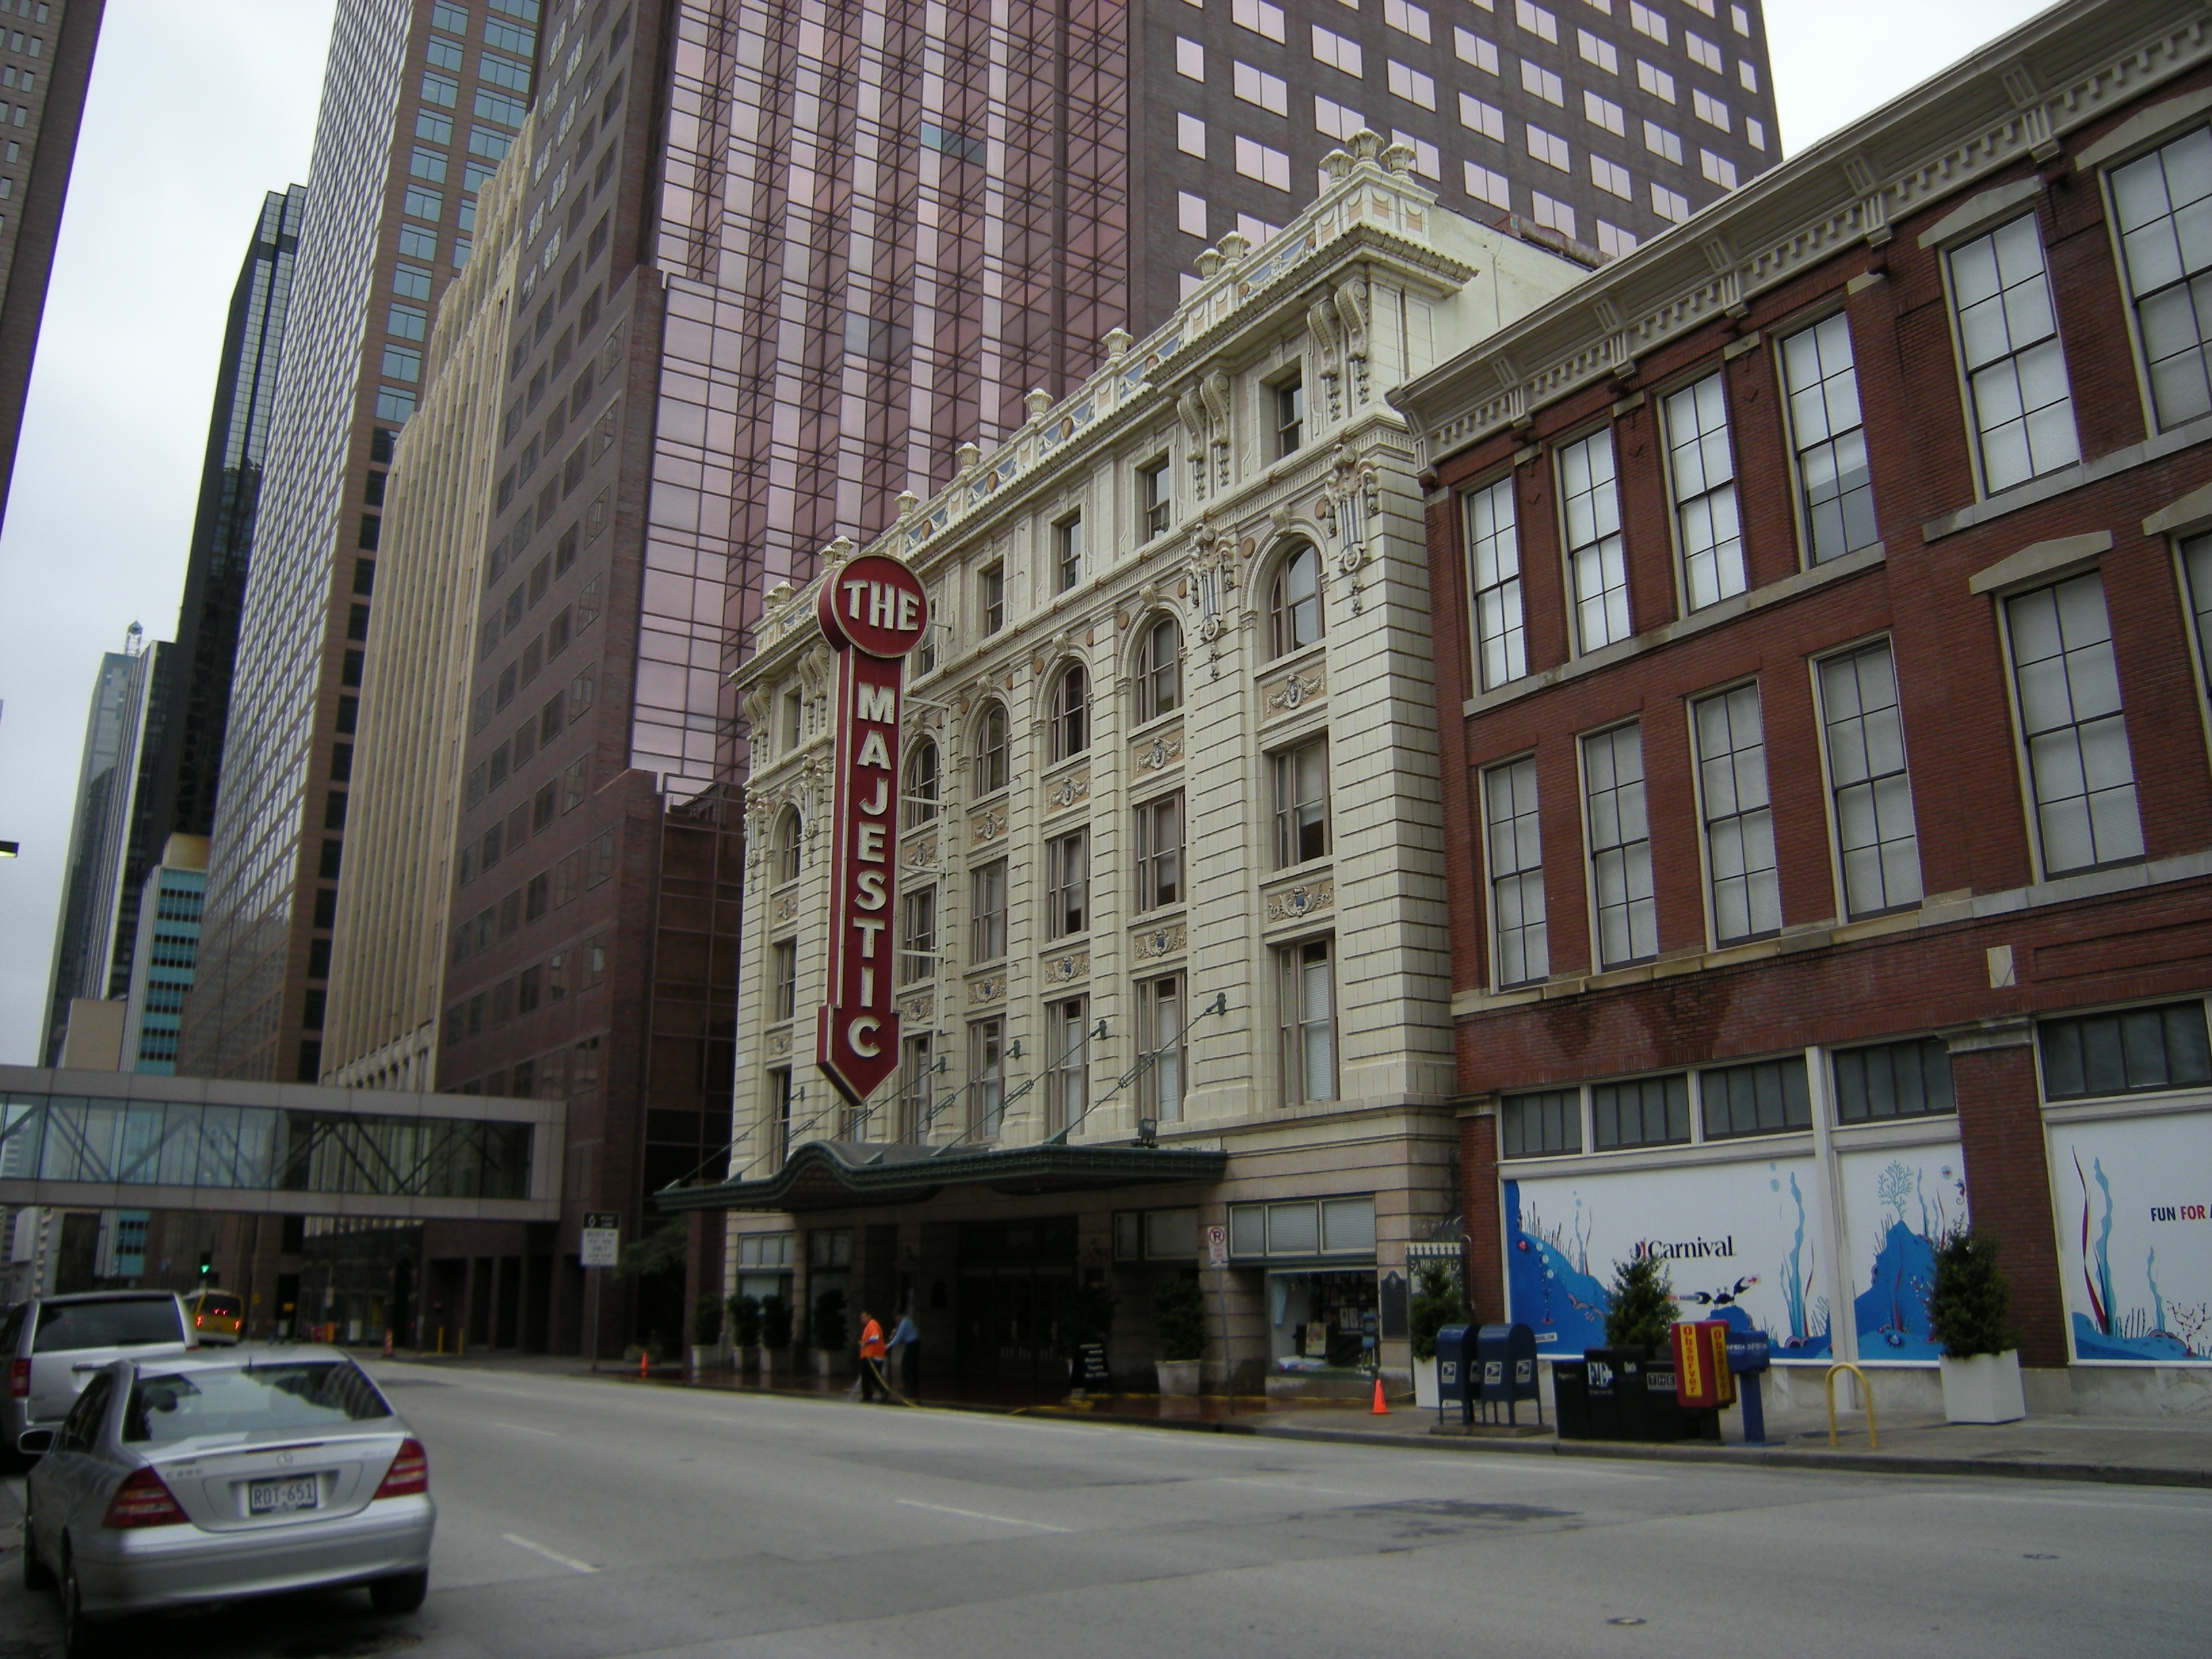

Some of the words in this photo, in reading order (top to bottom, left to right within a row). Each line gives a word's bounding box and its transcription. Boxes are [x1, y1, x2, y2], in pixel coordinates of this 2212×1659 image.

[844, 579, 919, 631] THE
[848, 682, 895, 1058] MAJESTIC
[2150, 1206, 2176, 1221] FUN
[2180, 1205, 2206, 1220] FOR
[1647, 1235, 1734, 1259] Carnival
[1683, 1326, 1697, 1394] Observer
